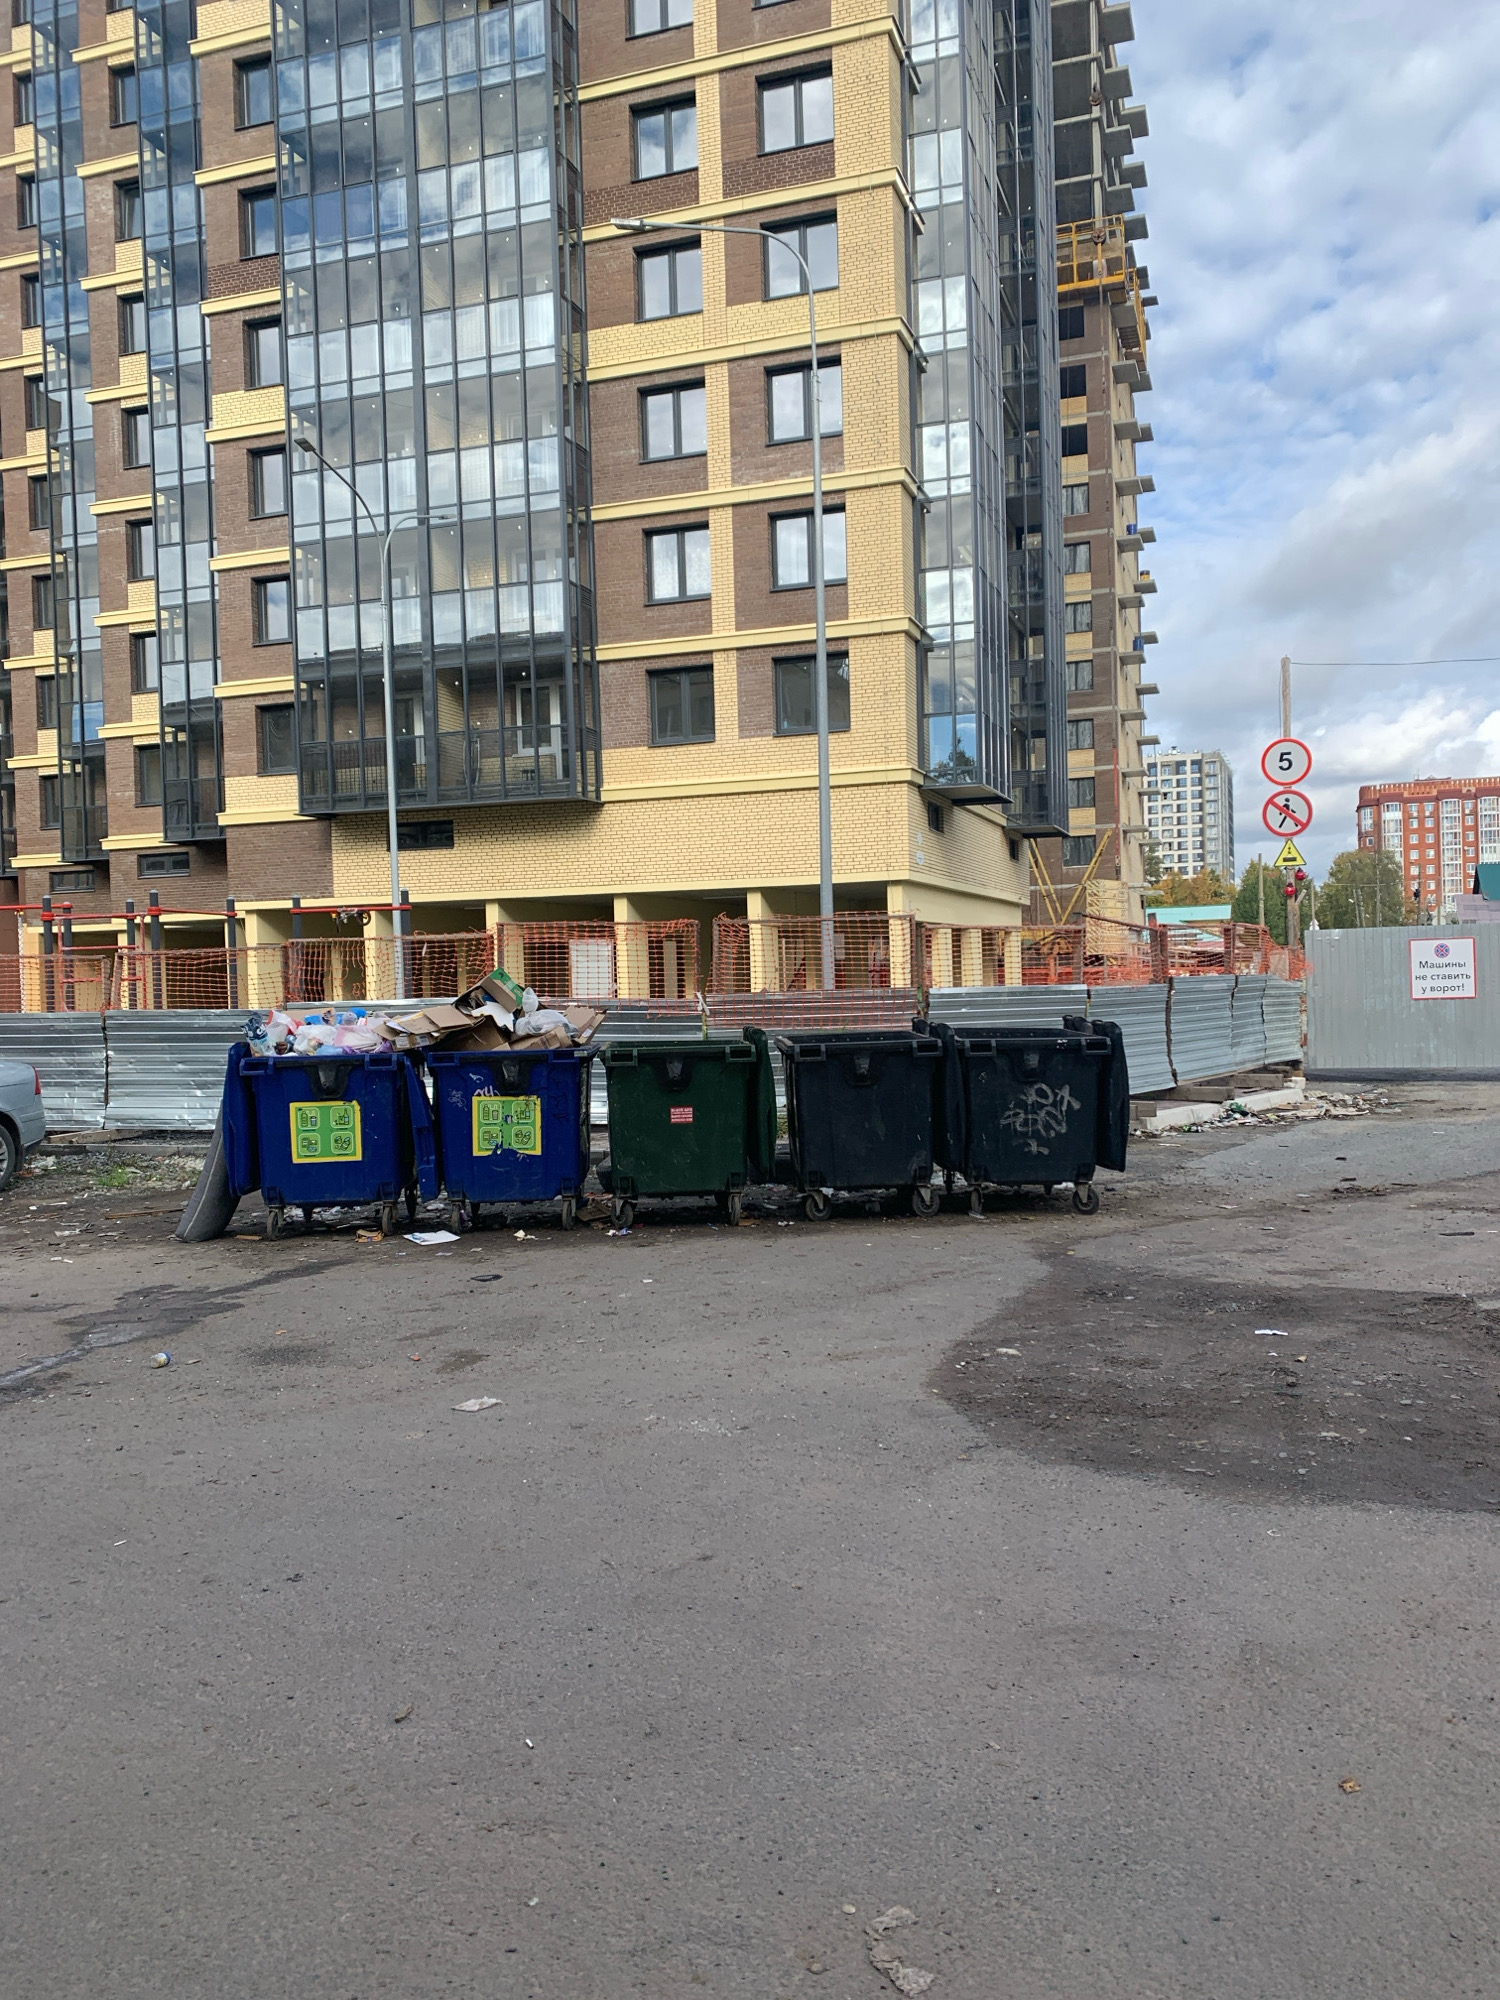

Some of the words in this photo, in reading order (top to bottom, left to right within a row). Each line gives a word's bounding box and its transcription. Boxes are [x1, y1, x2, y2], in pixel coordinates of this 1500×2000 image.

[1278, 751, 1293, 771] 5
[1419, 961, 1466, 969] Машины
[1421, 986, 1427, 994] у
[1430, 983, 1464, 993] ворот!
